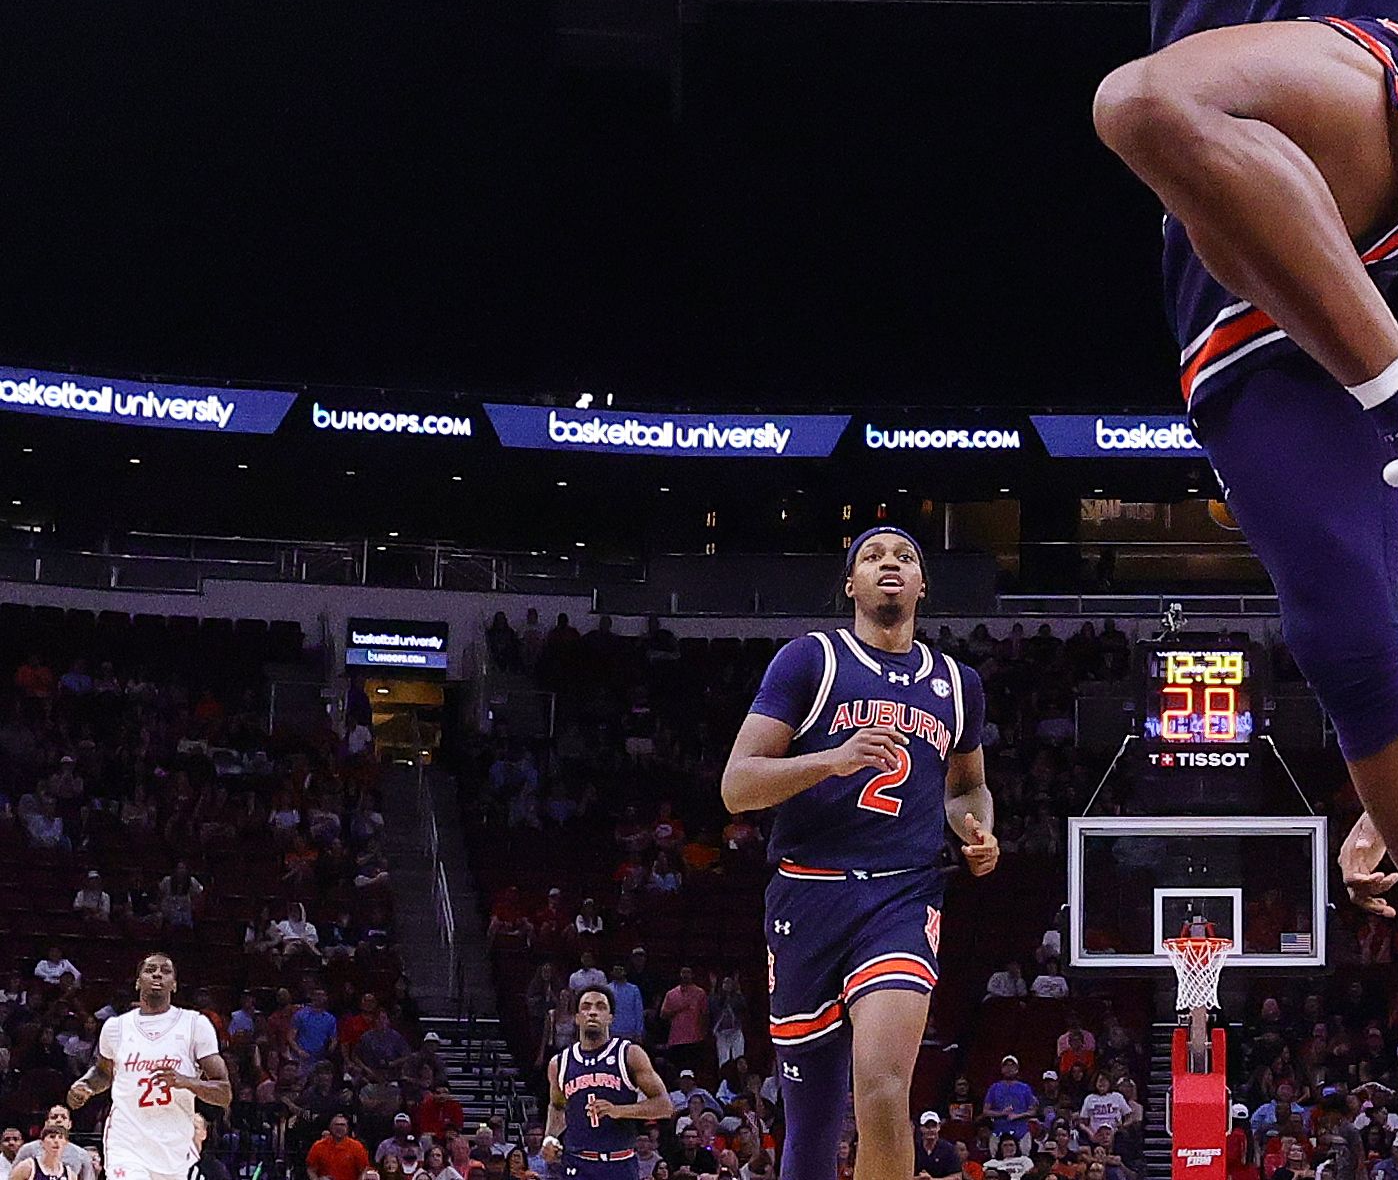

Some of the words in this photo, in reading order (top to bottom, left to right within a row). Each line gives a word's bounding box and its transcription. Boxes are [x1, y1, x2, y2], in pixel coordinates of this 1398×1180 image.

[0, 378, 112, 414] asketball
[114, 391, 235, 429] university
[548, 411, 673, 449] basketball
[676, 419, 791, 454] university
[1096, 418, 1202, 450] basketb
[827, 699, 952, 761] AUBURN
[1162, 687, 1235, 739] 28
[1175, 752, 1250, 767] TISSOT
[857, 743, 911, 817] 2
[124, 1051, 183, 1072] Houston
[137, 1077, 173, 1108] 23
[564, 1072, 621, 1100] AUBURN
